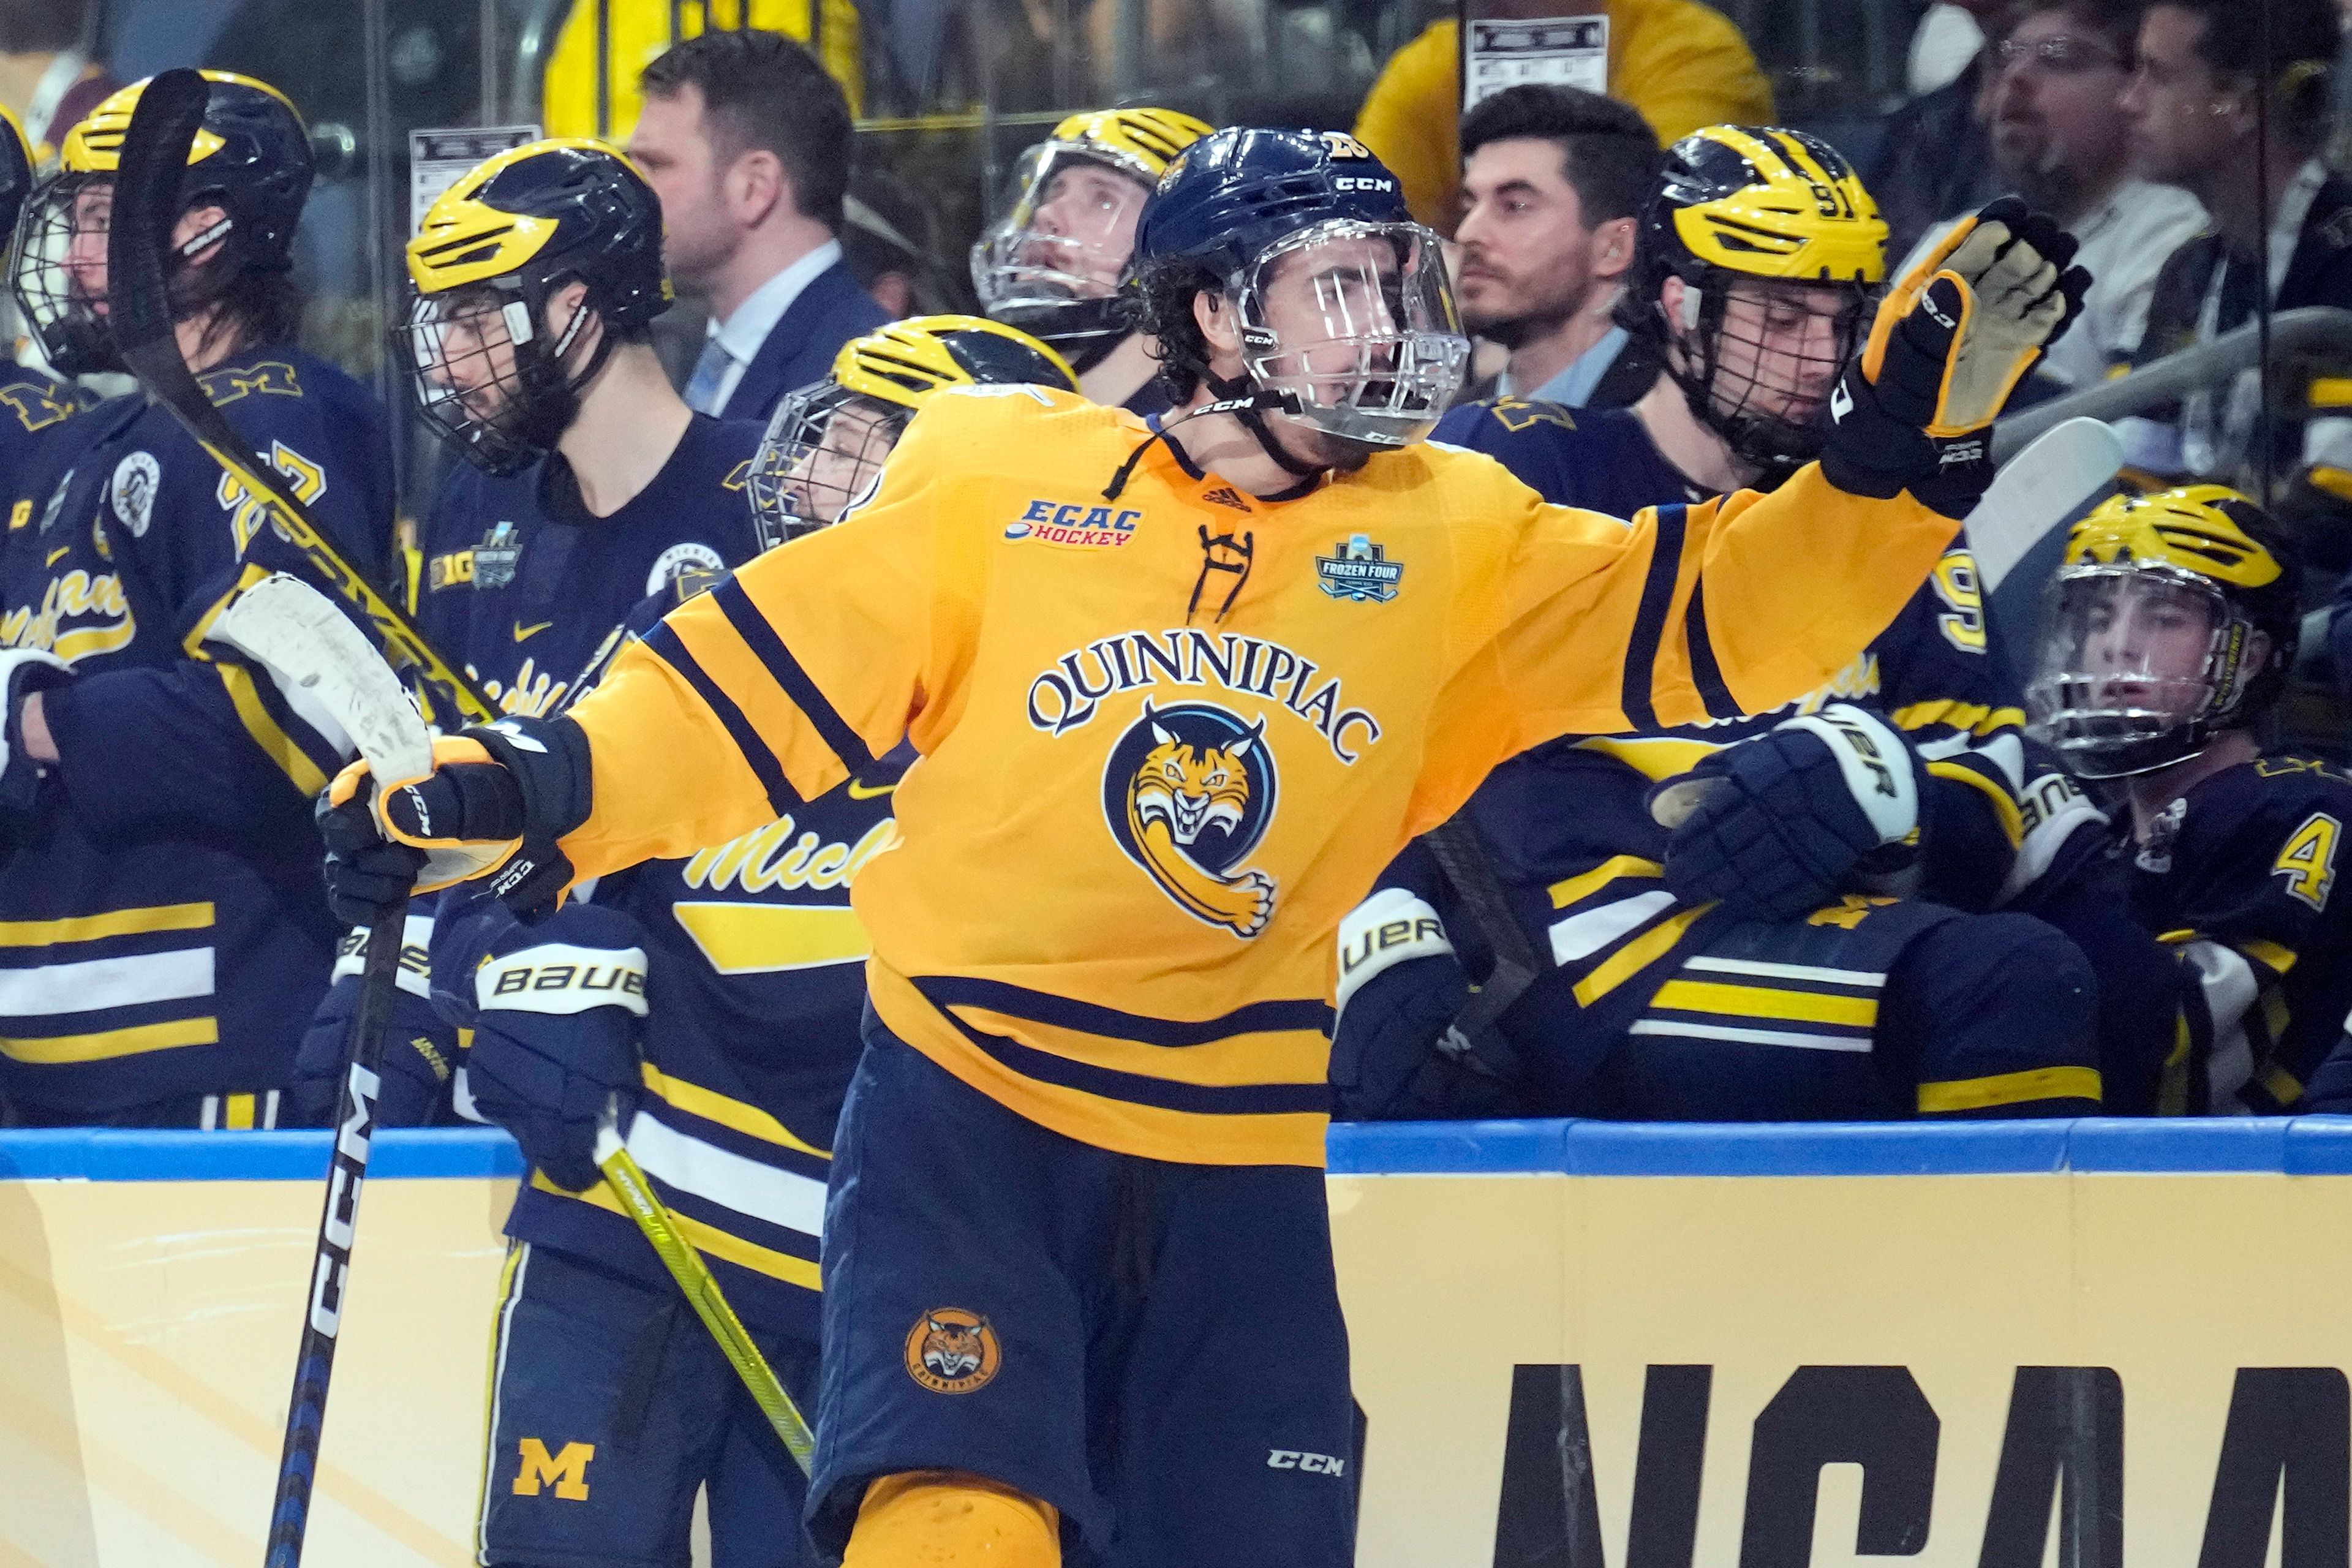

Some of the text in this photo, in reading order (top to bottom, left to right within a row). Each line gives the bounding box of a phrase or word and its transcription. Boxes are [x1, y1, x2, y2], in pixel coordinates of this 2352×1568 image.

[1335, 177, 1392, 192] CCM
[1811, 185, 1854, 218] 91
[1245, 334, 1273, 345] CCM
[1193, 397, 1254, 415] CCM
[1365, 431, 1404, 445] CC
[1021, 500, 1141, 531] ECAC
[1034, 525, 1131, 546] HOCKEY
[1322, 561, 1398, 579] FROZEN FOUR
[1028, 628, 1382, 766] QUINNIPIAC
[404, 785, 431, 837] CCM
[495, 861, 536, 895] CCM
[2270, 812, 2343, 913] 4
[311, 1061, 381, 1339] CCM
[512, 1438, 595, 1501] M
[1267, 1449, 1346, 1477] CCM
